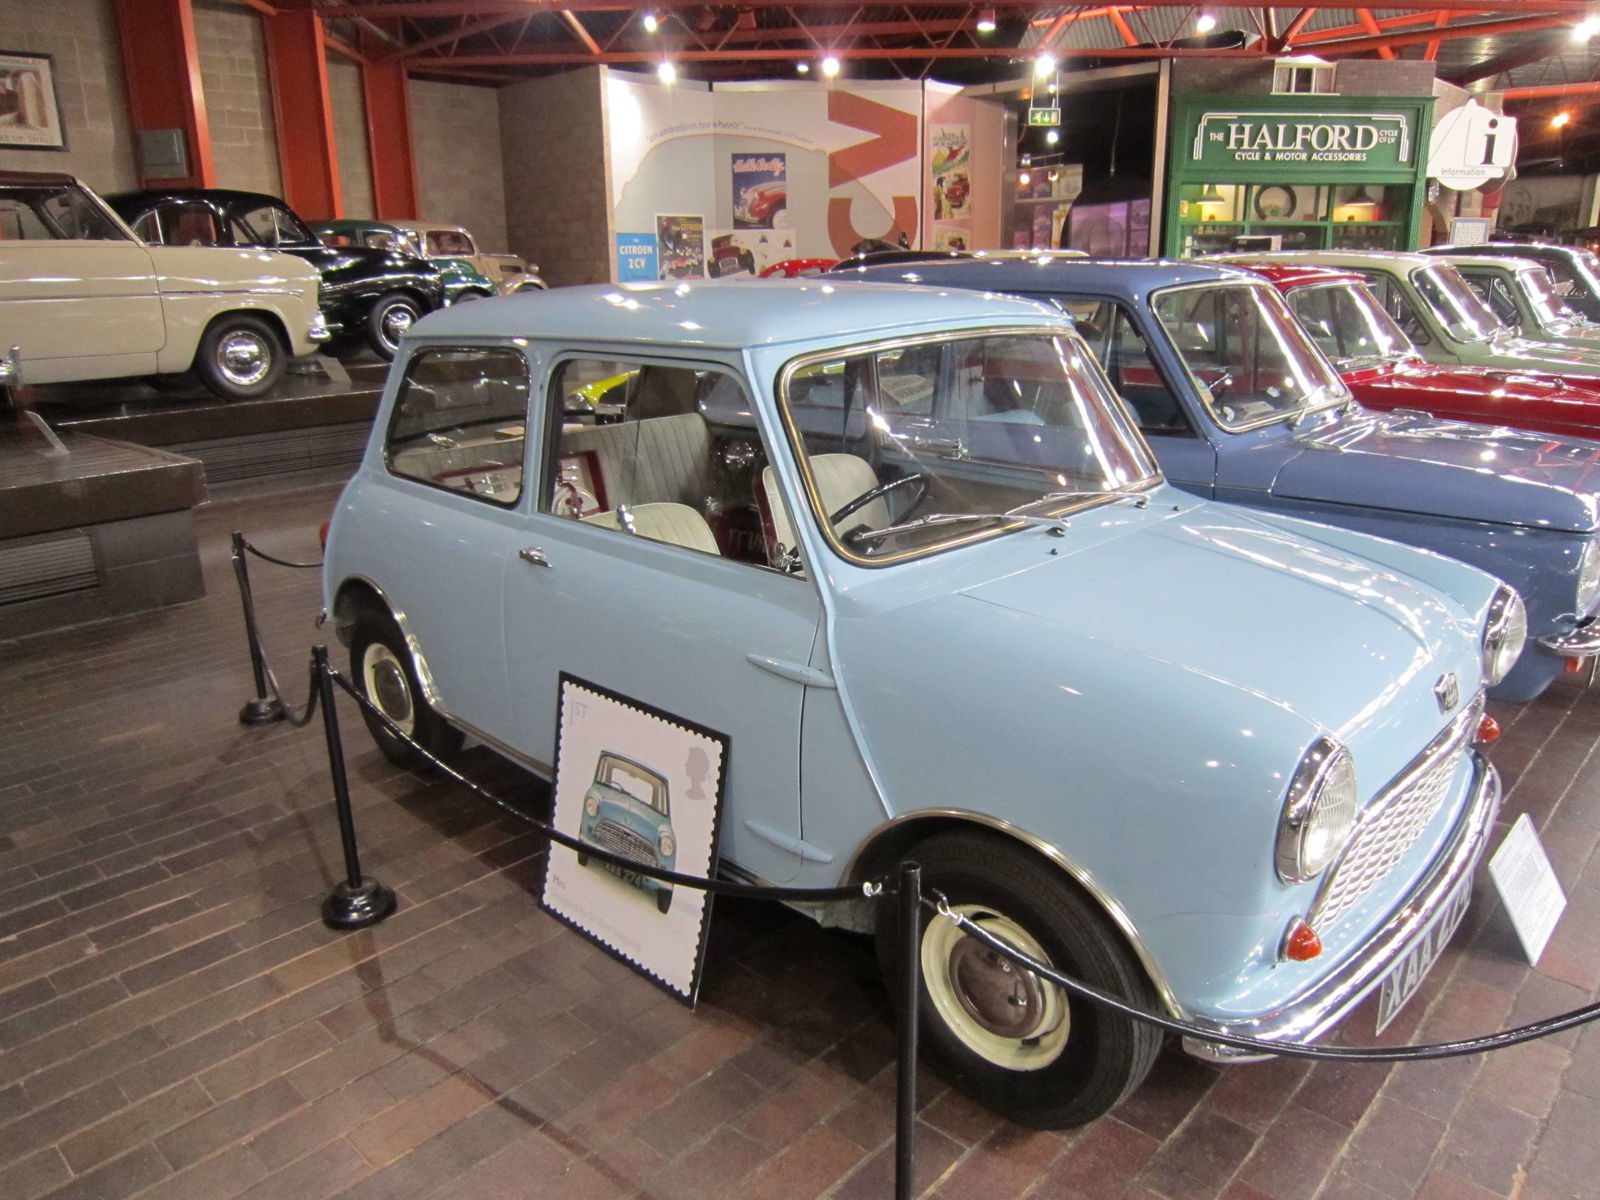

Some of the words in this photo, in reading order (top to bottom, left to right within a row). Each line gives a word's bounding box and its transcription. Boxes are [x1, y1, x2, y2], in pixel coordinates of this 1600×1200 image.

[659, 123, 688, 138] umbrella
[1209, 132, 1224, 141] THE
[1226, 123, 1379, 151] HALFORD
[1379, 129, 1398, 137] CYCLE
[1234, 152, 1261, 161] CYCLE
[1264, 152, 1271, 161] &
[1275, 152, 1308, 161] MOTOR
[1311, 152, 1367, 162] ACCESSORIES
[628, 258, 646, 269] 2CV
[1385, 928, 1432, 1019] XAA
